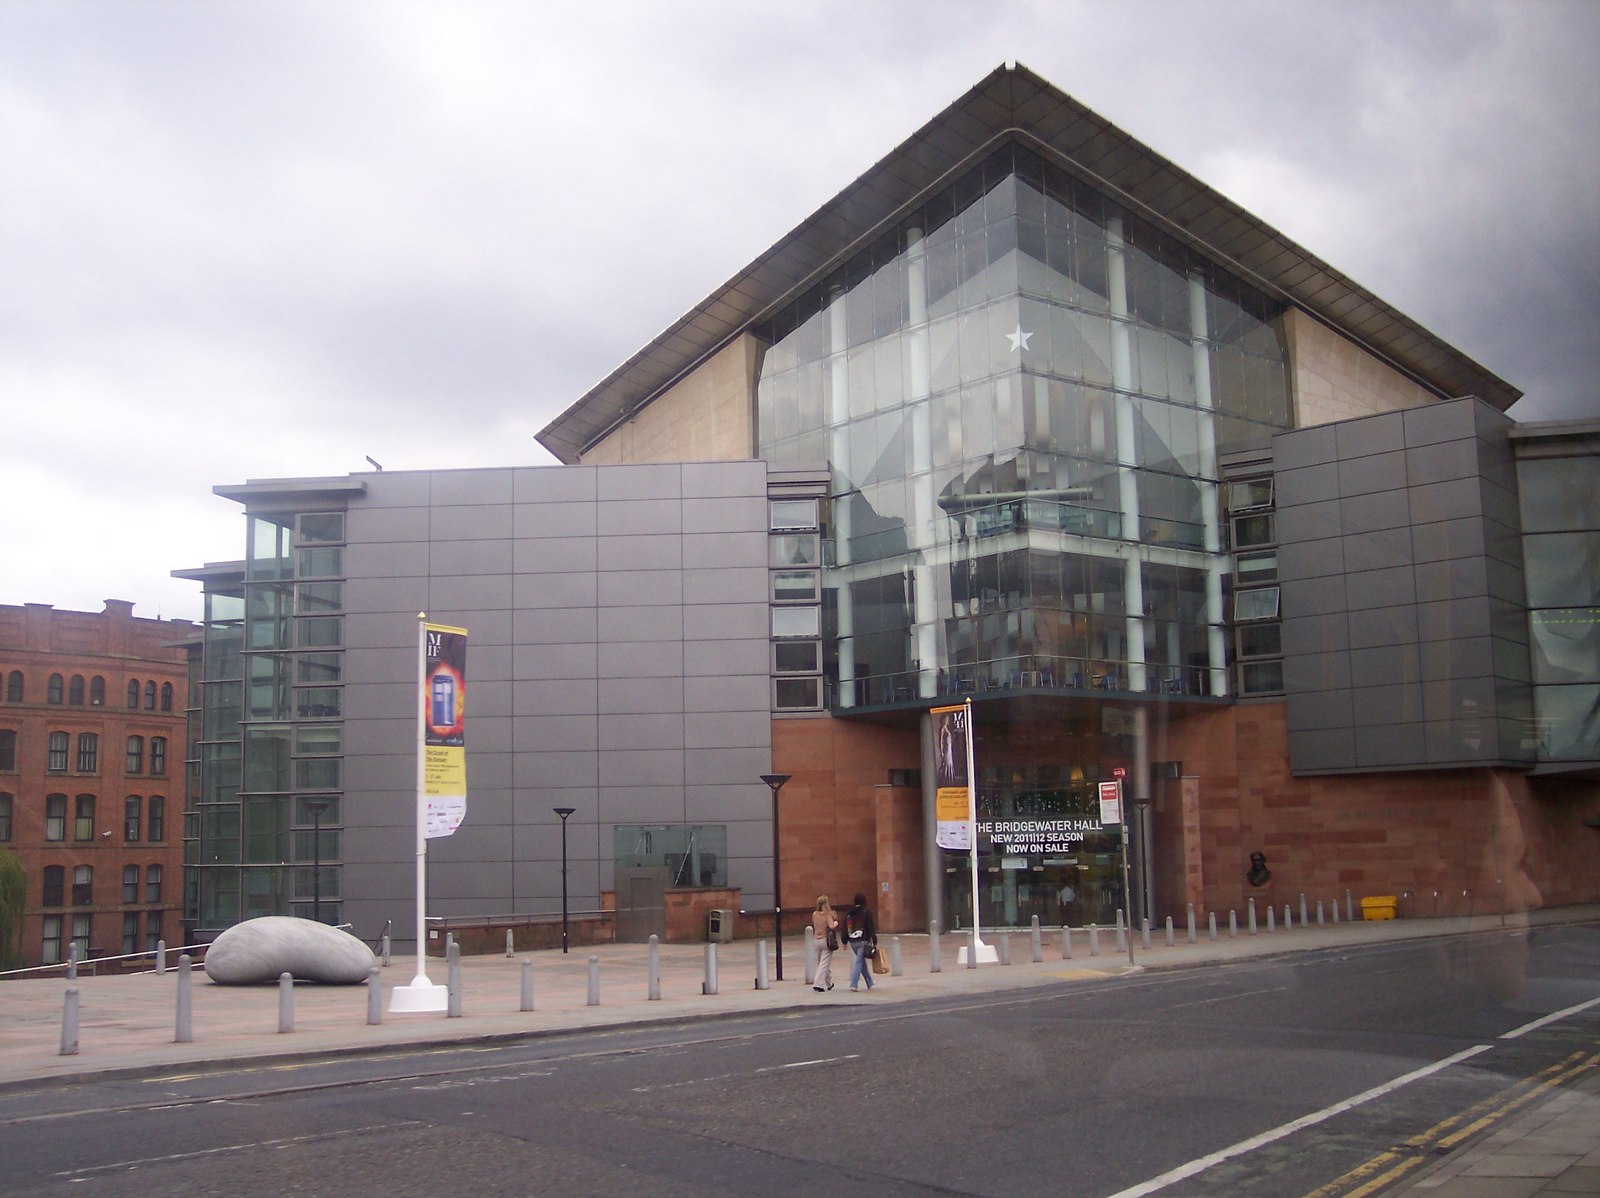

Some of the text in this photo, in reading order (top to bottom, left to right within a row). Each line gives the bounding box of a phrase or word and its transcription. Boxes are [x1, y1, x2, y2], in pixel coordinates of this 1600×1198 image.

[995, 820, 1071, 832] BRIDGEWATER
[1074, 819, 1103, 830] HALL
[990, 834, 1013, 843] NEW
[1046, 832, 1084, 842] SEASON
[1006, 843, 1069, 853] NOW ON SALE
